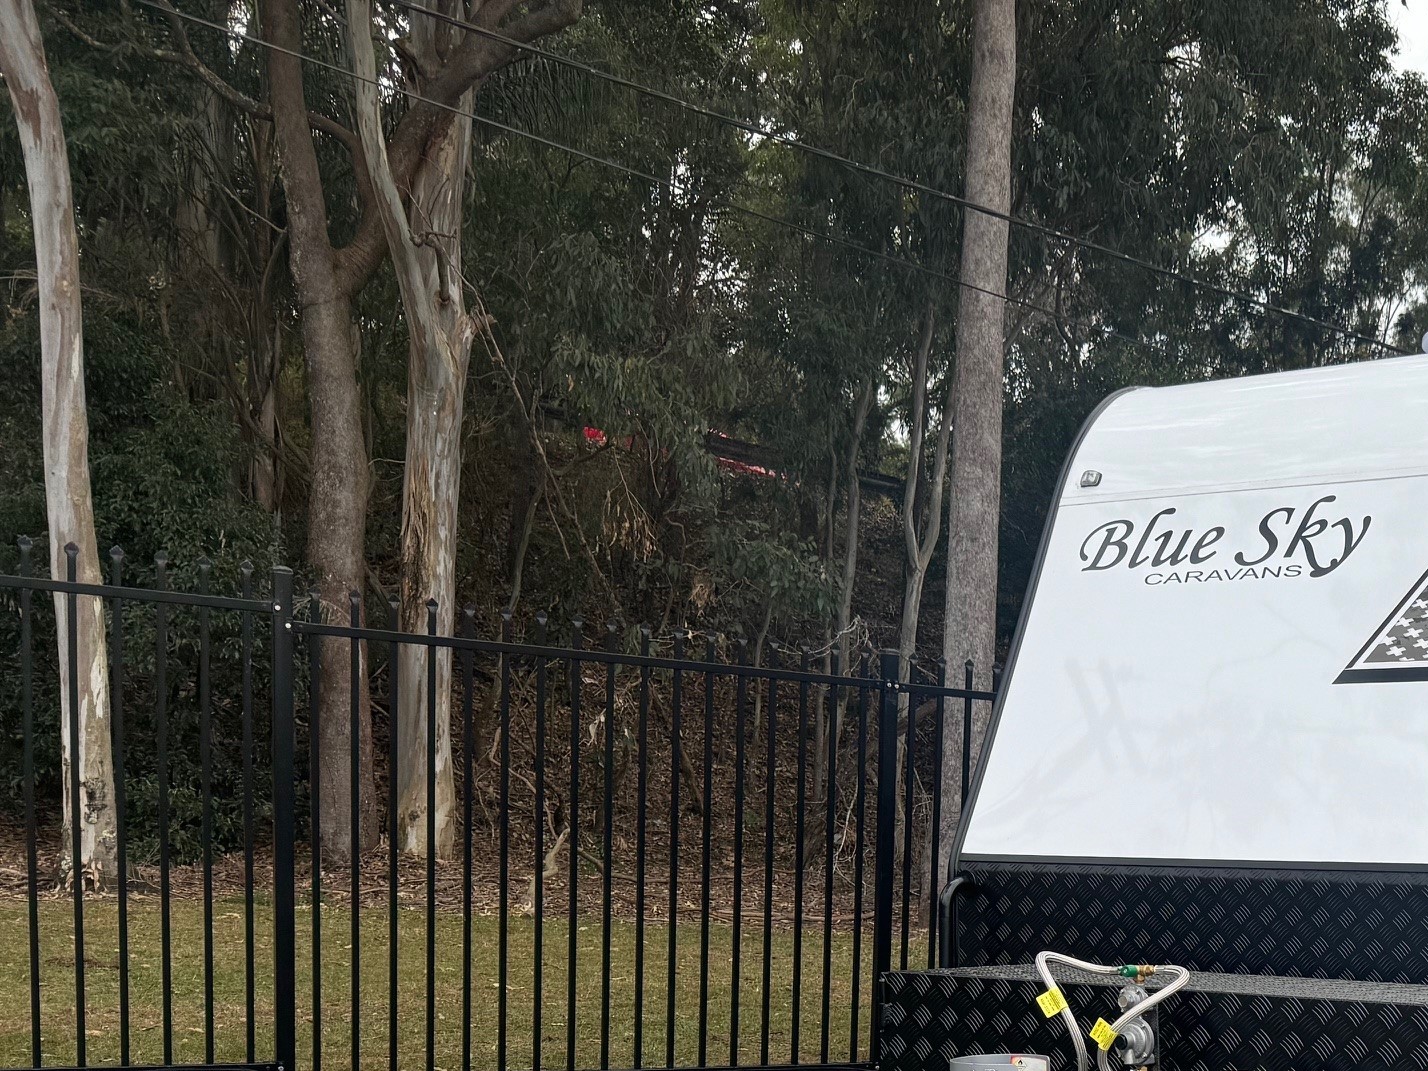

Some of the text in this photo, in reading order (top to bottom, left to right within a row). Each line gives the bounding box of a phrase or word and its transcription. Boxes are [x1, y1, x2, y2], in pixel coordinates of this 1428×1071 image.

[1079, 494, 1372, 579] Blue Sky
[1144, 564, 1303, 586] CARAVANS
